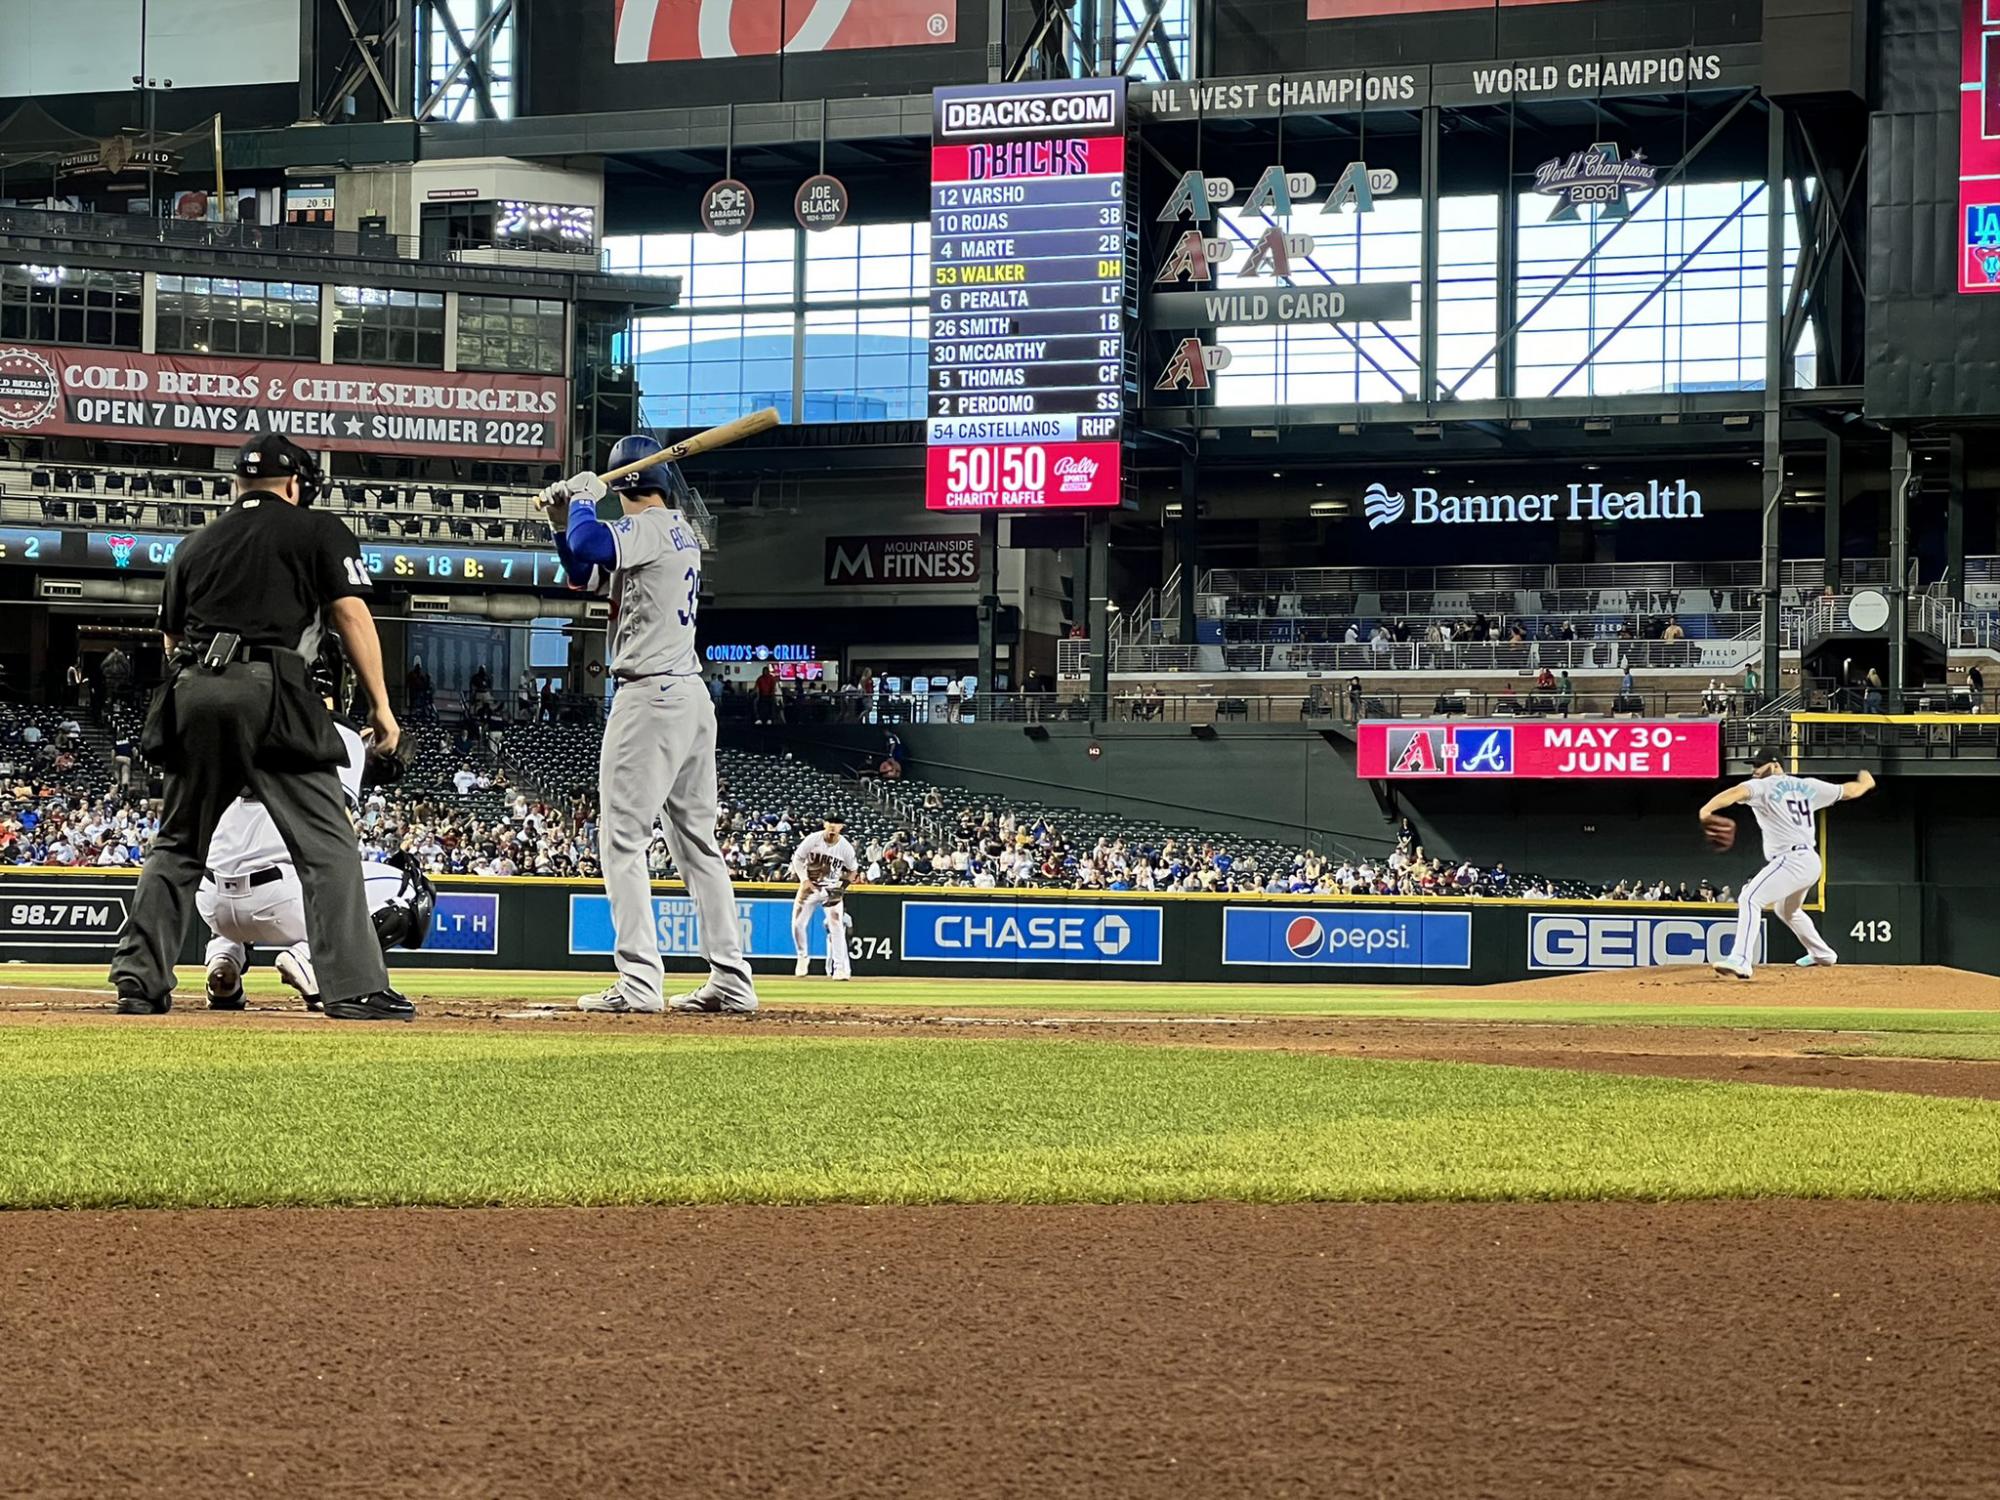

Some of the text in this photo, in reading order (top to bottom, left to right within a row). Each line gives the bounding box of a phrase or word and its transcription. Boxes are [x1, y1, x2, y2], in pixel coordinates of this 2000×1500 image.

[1472, 55, 1721, 94] WORLD CHAMPIONS
[1151, 74, 1415, 113] NL WEST CHAMPIONS
[948, 96, 1108, 127] DBACKS.COM
[1536, 152, 1655, 185] World Champions
[809, 186, 831, 200] JOE
[938, 181, 1121, 206] 12 VARSHO C
[1207, 181, 1229, 198] 99
[1289, 177, 1309, 194] 01
[1371, 173, 1392, 191] 02
[1571, 184, 1619, 201] 2001
[306, 198, 331, 208] 20 51
[801, 199, 840, 214] BLACK
[938, 208, 1120, 232] 10 ROJAS 3B
[941, 235, 1120, 258] 4 MARTE 2B
[1207, 241, 1227, 258] 07
[1289, 237, 1307, 254] 11
[936, 260, 1120, 284] 53 WALKER DH
[940, 286, 1119, 310] 6 PERALTA LF
[1205, 293, 1345, 322] WILD CARD
[935, 313, 1119, 336] 26 SMITH 1B
[935, 340, 1119, 363] 30 MCCARTHY RF
[1207, 349, 1223, 367] 17
[939, 365, 1119, 388] 5 THOMAS CF
[64, 364, 558, 414] COLD BEERS & CHEESEBURGERS
[938, 392, 1119, 415] 2 PERDOMO SS
[77, 398, 544, 446] OPEN 7 DAYS A WEEK SUMMER 2022
[934, 418, 1116, 440] 54 CASTELLANOS RHP
[1053, 456, 1099, 479] Bally
[946, 491, 1045, 506] CHARITY RAFFLE
[1411, 479, 1704, 524] Banner Health
[24, 535, 40, 558] 2
[885, 540, 974, 553] MOUNTAINSIDE
[394, 555, 415, 576] S:
[427, 555, 452, 576] 18
[464, 558, 484, 578] B:
[501, 558, 513, 578] 7
[884, 553, 975, 577] FITNESS
[706, 644, 810, 660] GONZO'S GRILL
[1444, 745, 1457, 756] VS
[1544, 728, 1620, 748] MAY
[1630, 727, 1688, 748] 30-
[1557, 752, 1671, 773] JUNE 1
[1786, 799, 1812, 828] 54
[11, 904, 109, 926] 98.7 FM
[658, 901, 698, 916] BUD
[934, 916, 1085, 949] CHASE
[1329, 924, 1407, 954] pepsi
[1533, 918, 1763, 967] GEICO
[1850, 920, 1893, 942] 413
[849, 936, 893, 960] 374
